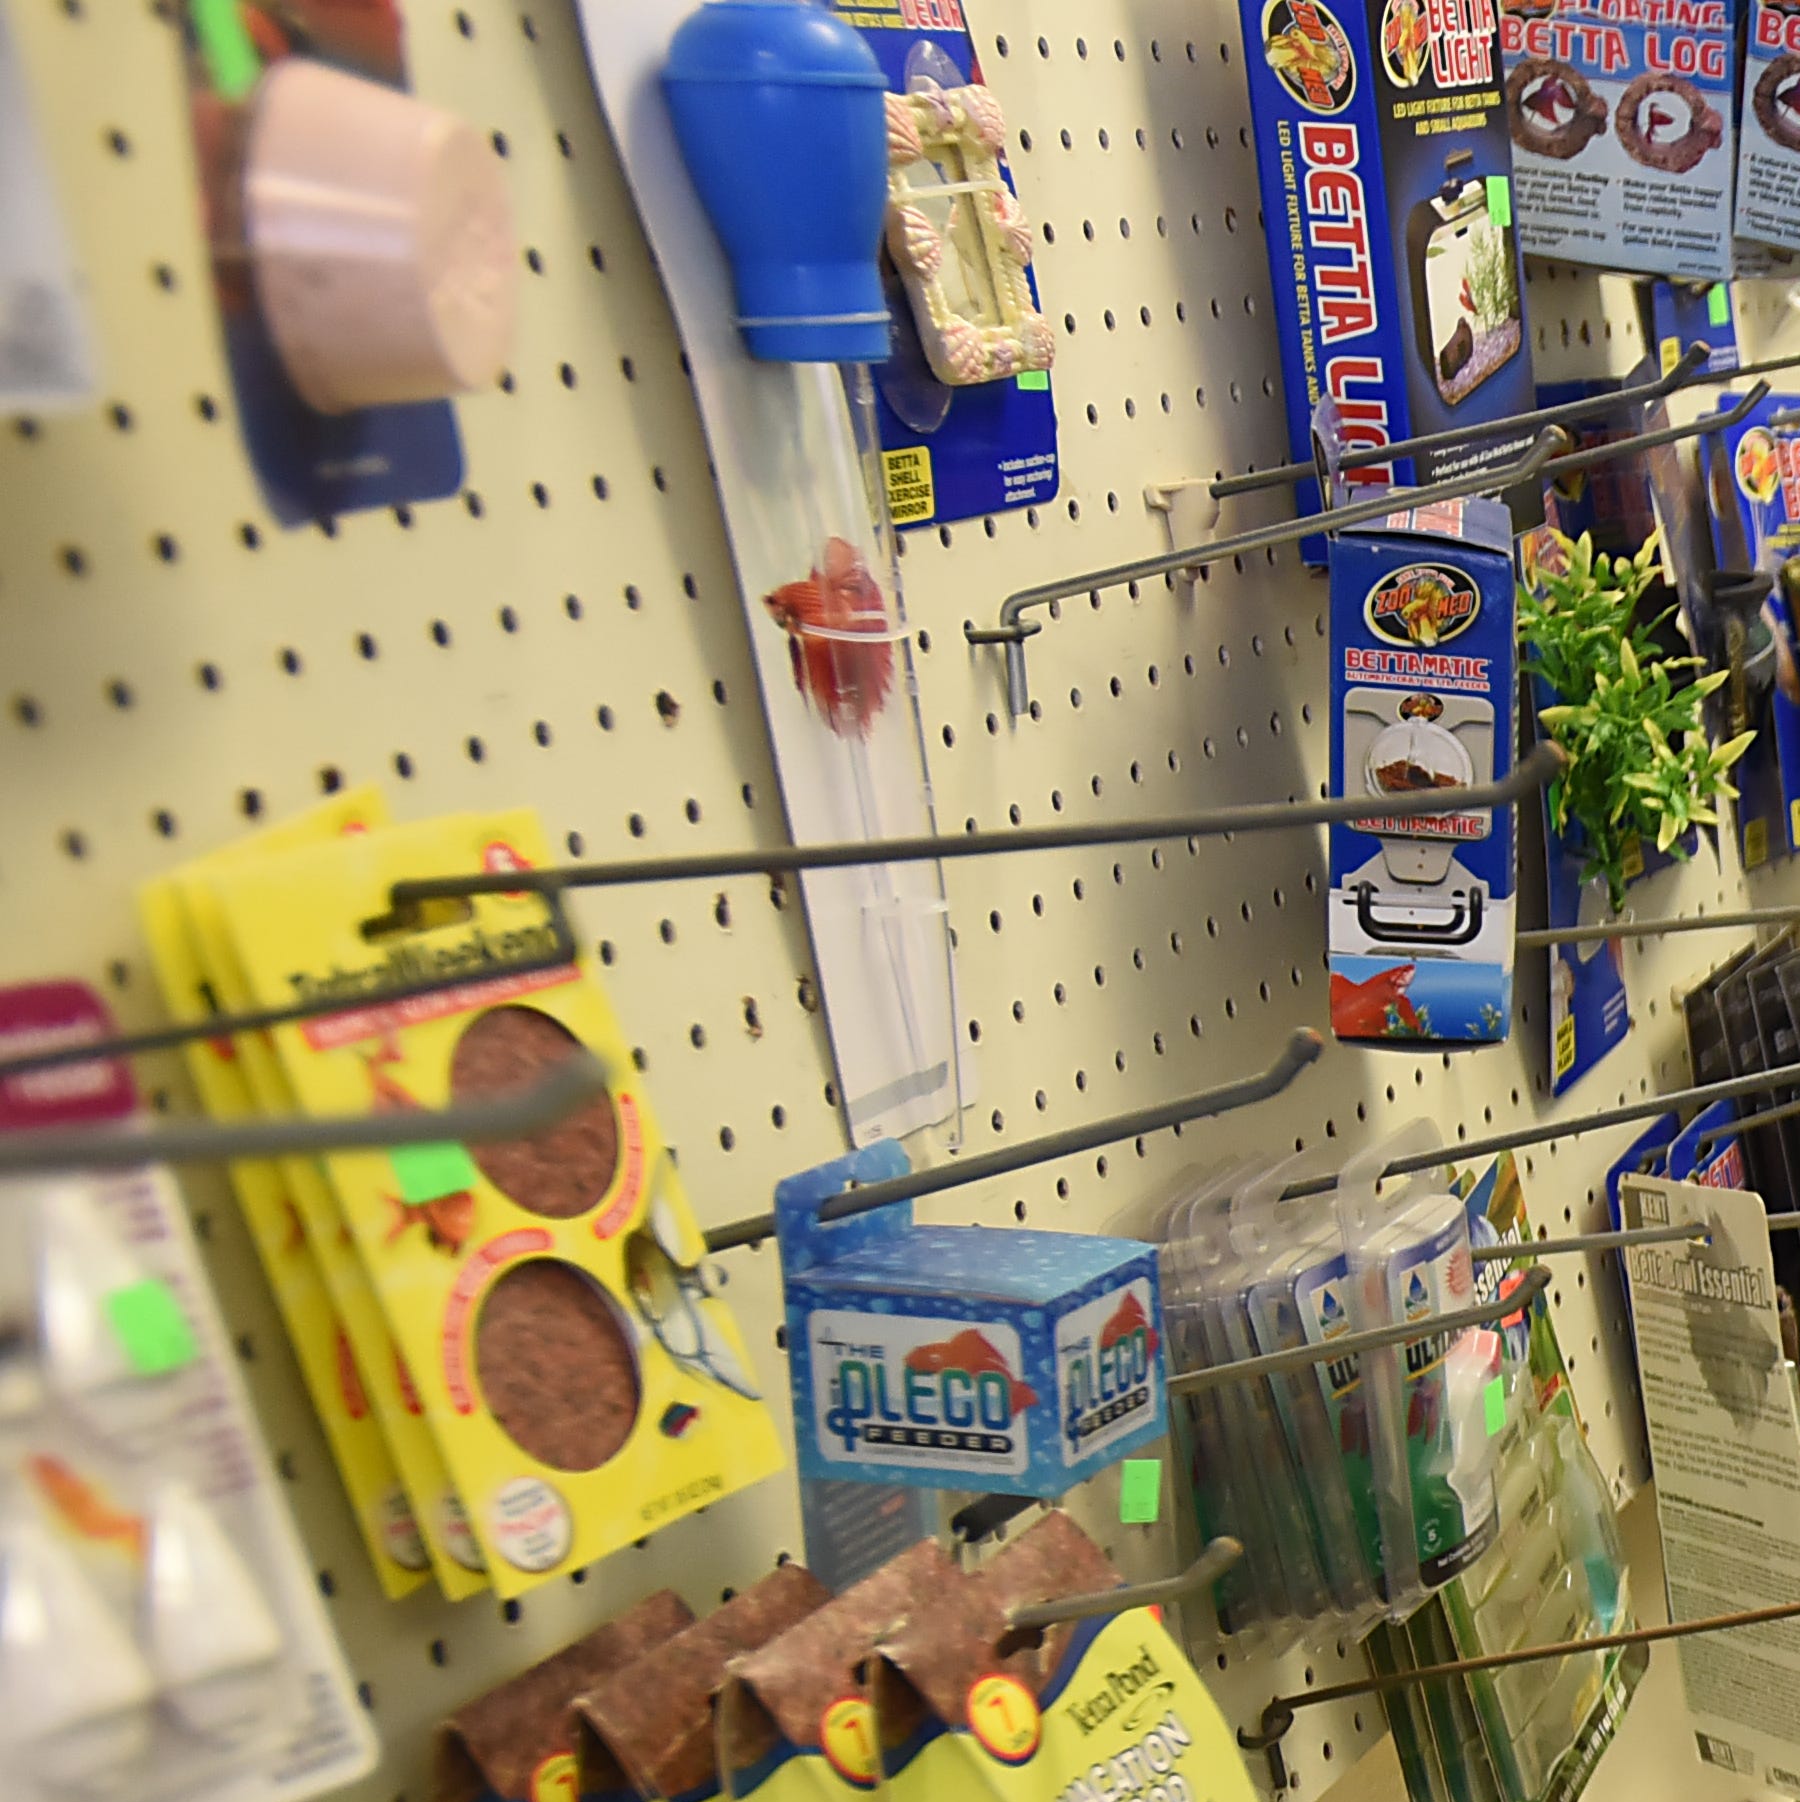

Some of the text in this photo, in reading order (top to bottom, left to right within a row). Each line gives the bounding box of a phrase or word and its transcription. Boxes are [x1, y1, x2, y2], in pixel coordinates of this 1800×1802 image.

[1431, 36, 1494, 89] LIGHT
[1501, 15, 1727, 78] BETTA LOG
[1277, 120, 1292, 147] LED
[1281, 151, 1298, 191] LIGHT
[1287, 195, 1305, 251] FIXTURE
[1297, 121, 1379, 346] BETTA
[1292, 253, 1306, 277] FOR
[1295, 280, 1311, 325] BETTA
[1299, 325, 1318, 372] TANKS
[887, 454, 920, 471] BETTA
[887, 484, 931, 504] XERCISE
[1375, 587, 1411, 617] ZOO
[1345, 647, 1489, 680] BETTAMATIC
[1699, 1261, 1769, 1309] Essential
[832, 1344, 885, 1360] THE
[826, 1359, 1012, 1453] PLECO
[1067, 1326, 1147, 1454] PLECO
[866, 1426, 1012, 1452] FEEDER
